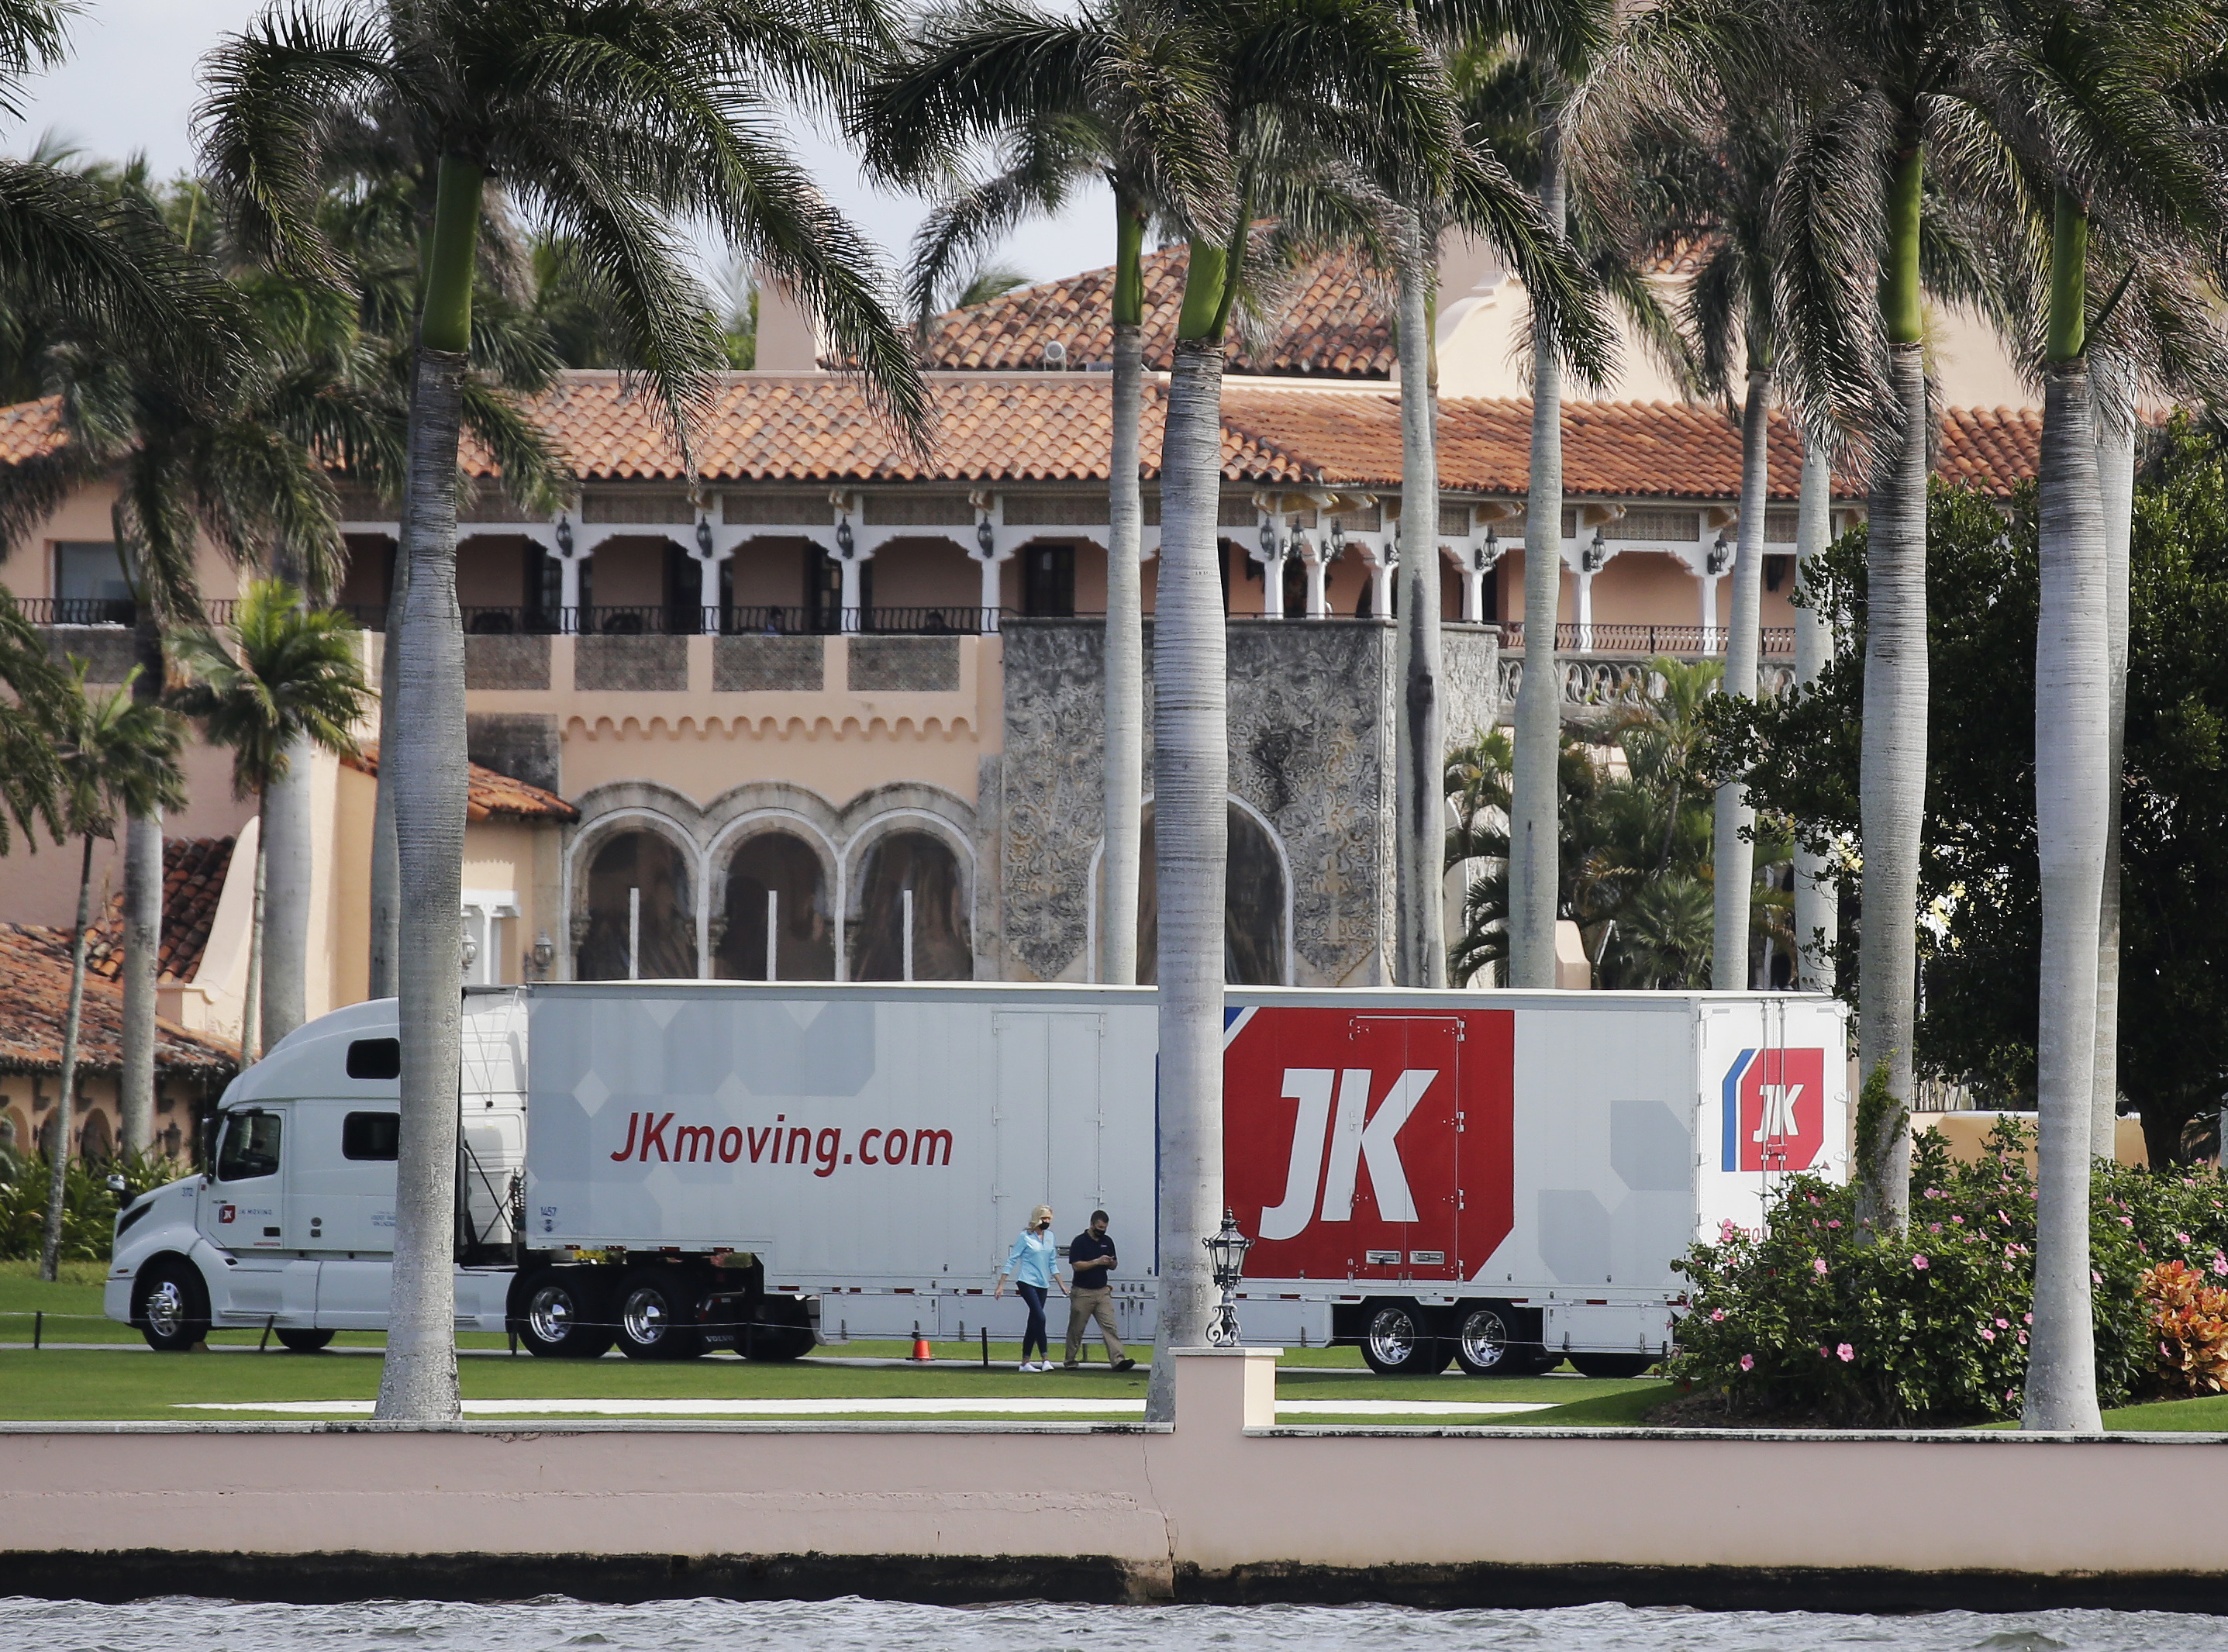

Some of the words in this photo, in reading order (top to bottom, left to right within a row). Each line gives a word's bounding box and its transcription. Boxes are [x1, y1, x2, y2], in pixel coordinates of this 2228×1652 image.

[610, 1112, 954, 1178] JKmoving.com
[1752, 1084, 1806, 1143] JK
[1258, 1067, 1440, 1240] JK
